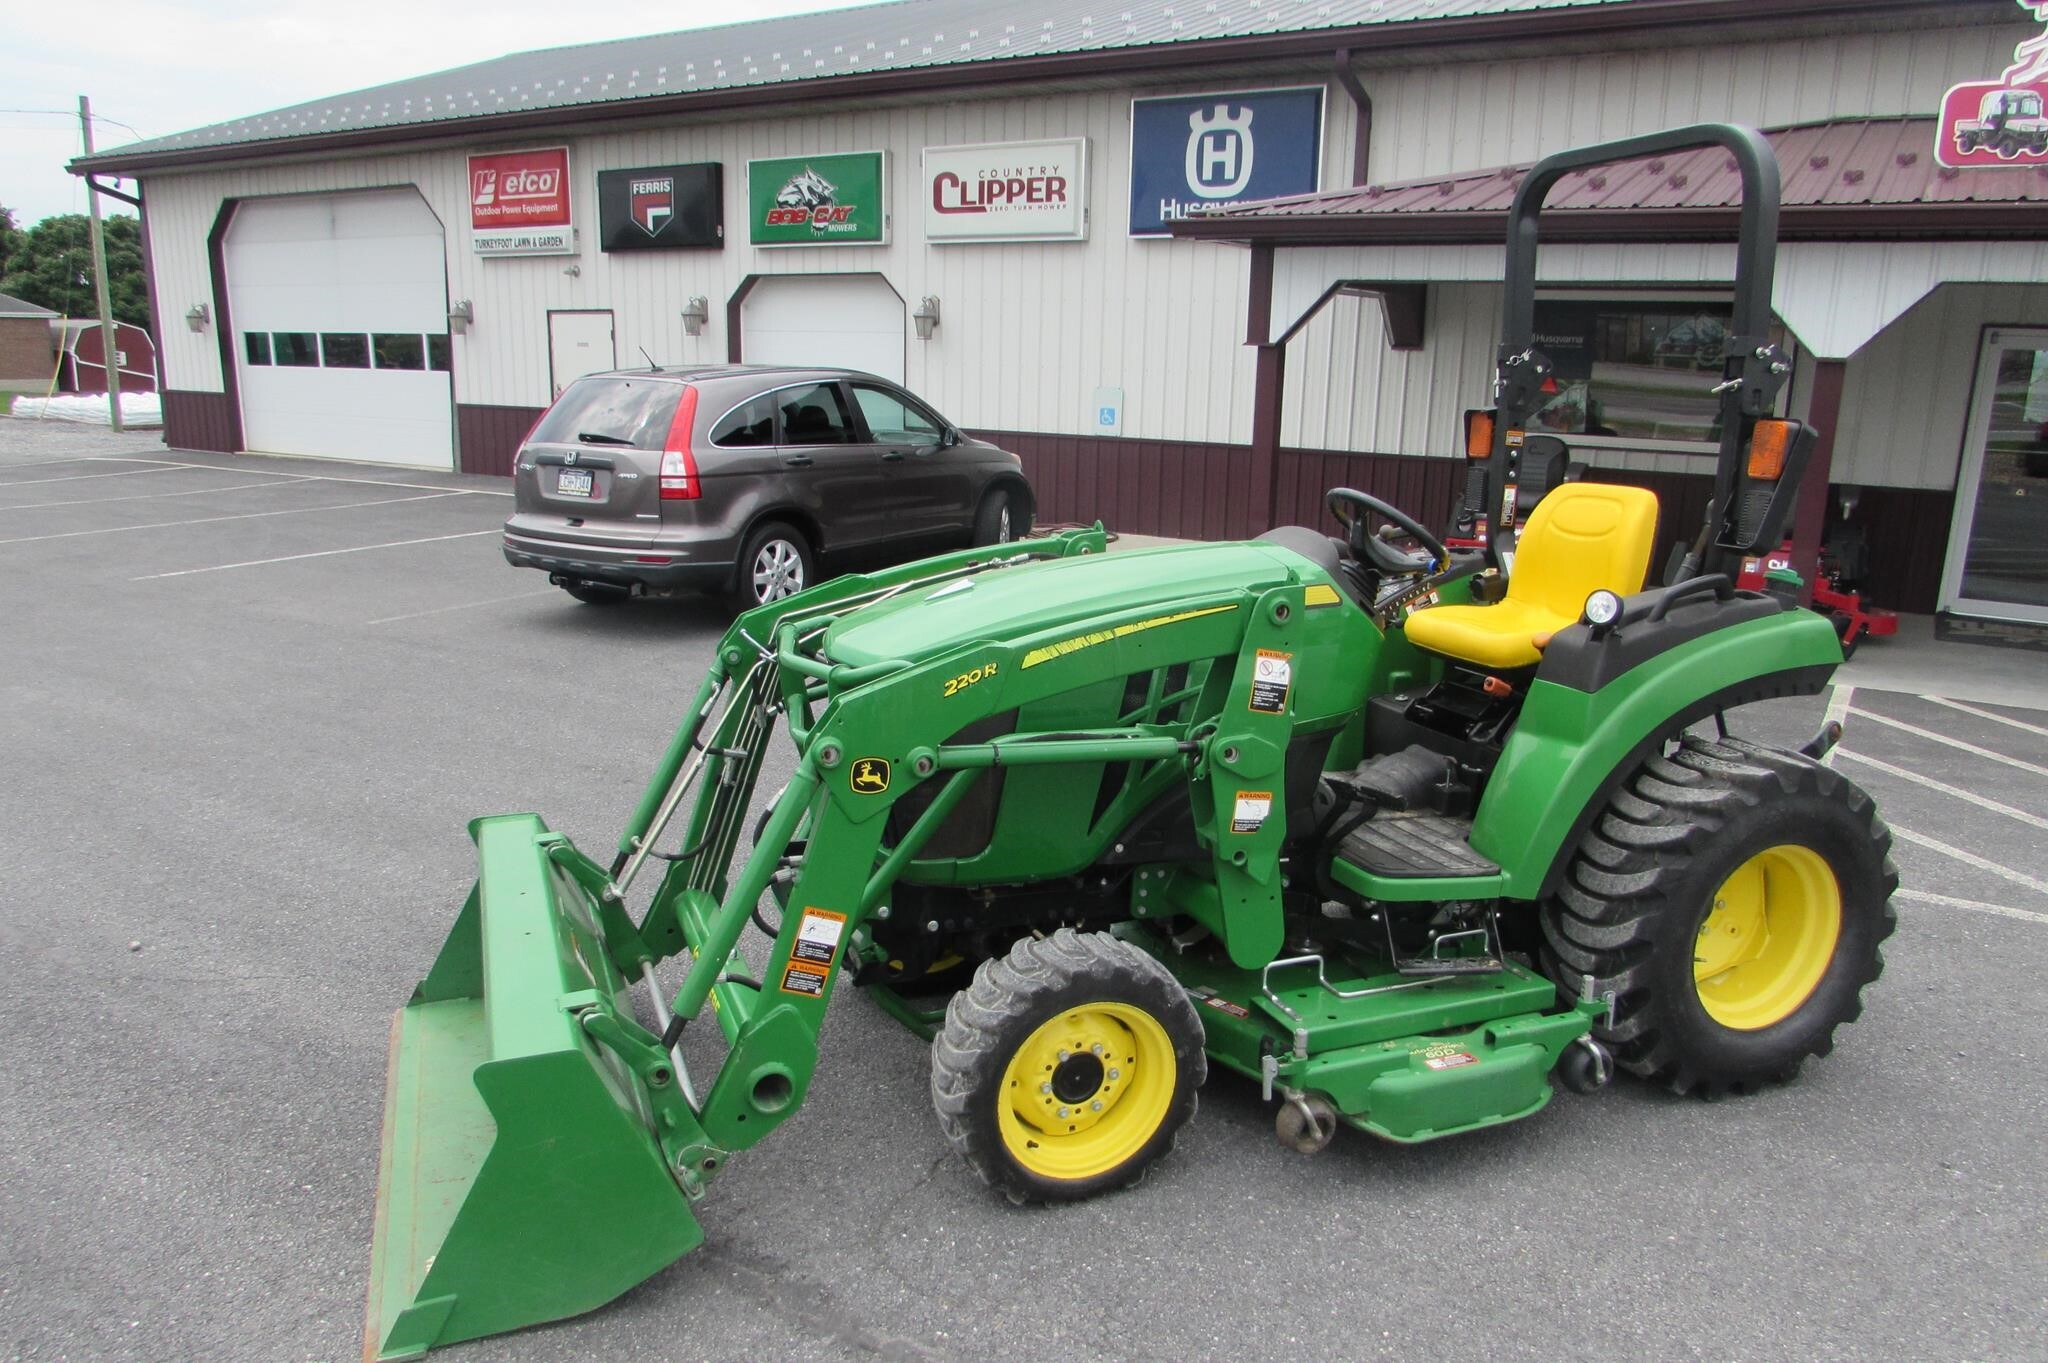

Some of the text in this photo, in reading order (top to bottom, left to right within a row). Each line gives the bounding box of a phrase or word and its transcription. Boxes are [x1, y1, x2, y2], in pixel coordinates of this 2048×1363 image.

[978, 165, 1059, 179] COUNTRY
[505, 169, 552, 193] efco
[633, 181, 671, 194] FERRIS
[933, 171, 1067, 214] CLIPPER
[474, 203, 558, 216] Outdoor Power Equipment
[1037, 203, 1066, 211] MOWER
[827, 223, 857, 233] MOWERS
[474, 236, 564, 249] TURKEYFOOT LAWN & GARDEN
[1243, 792, 1270, 800] WARNING
